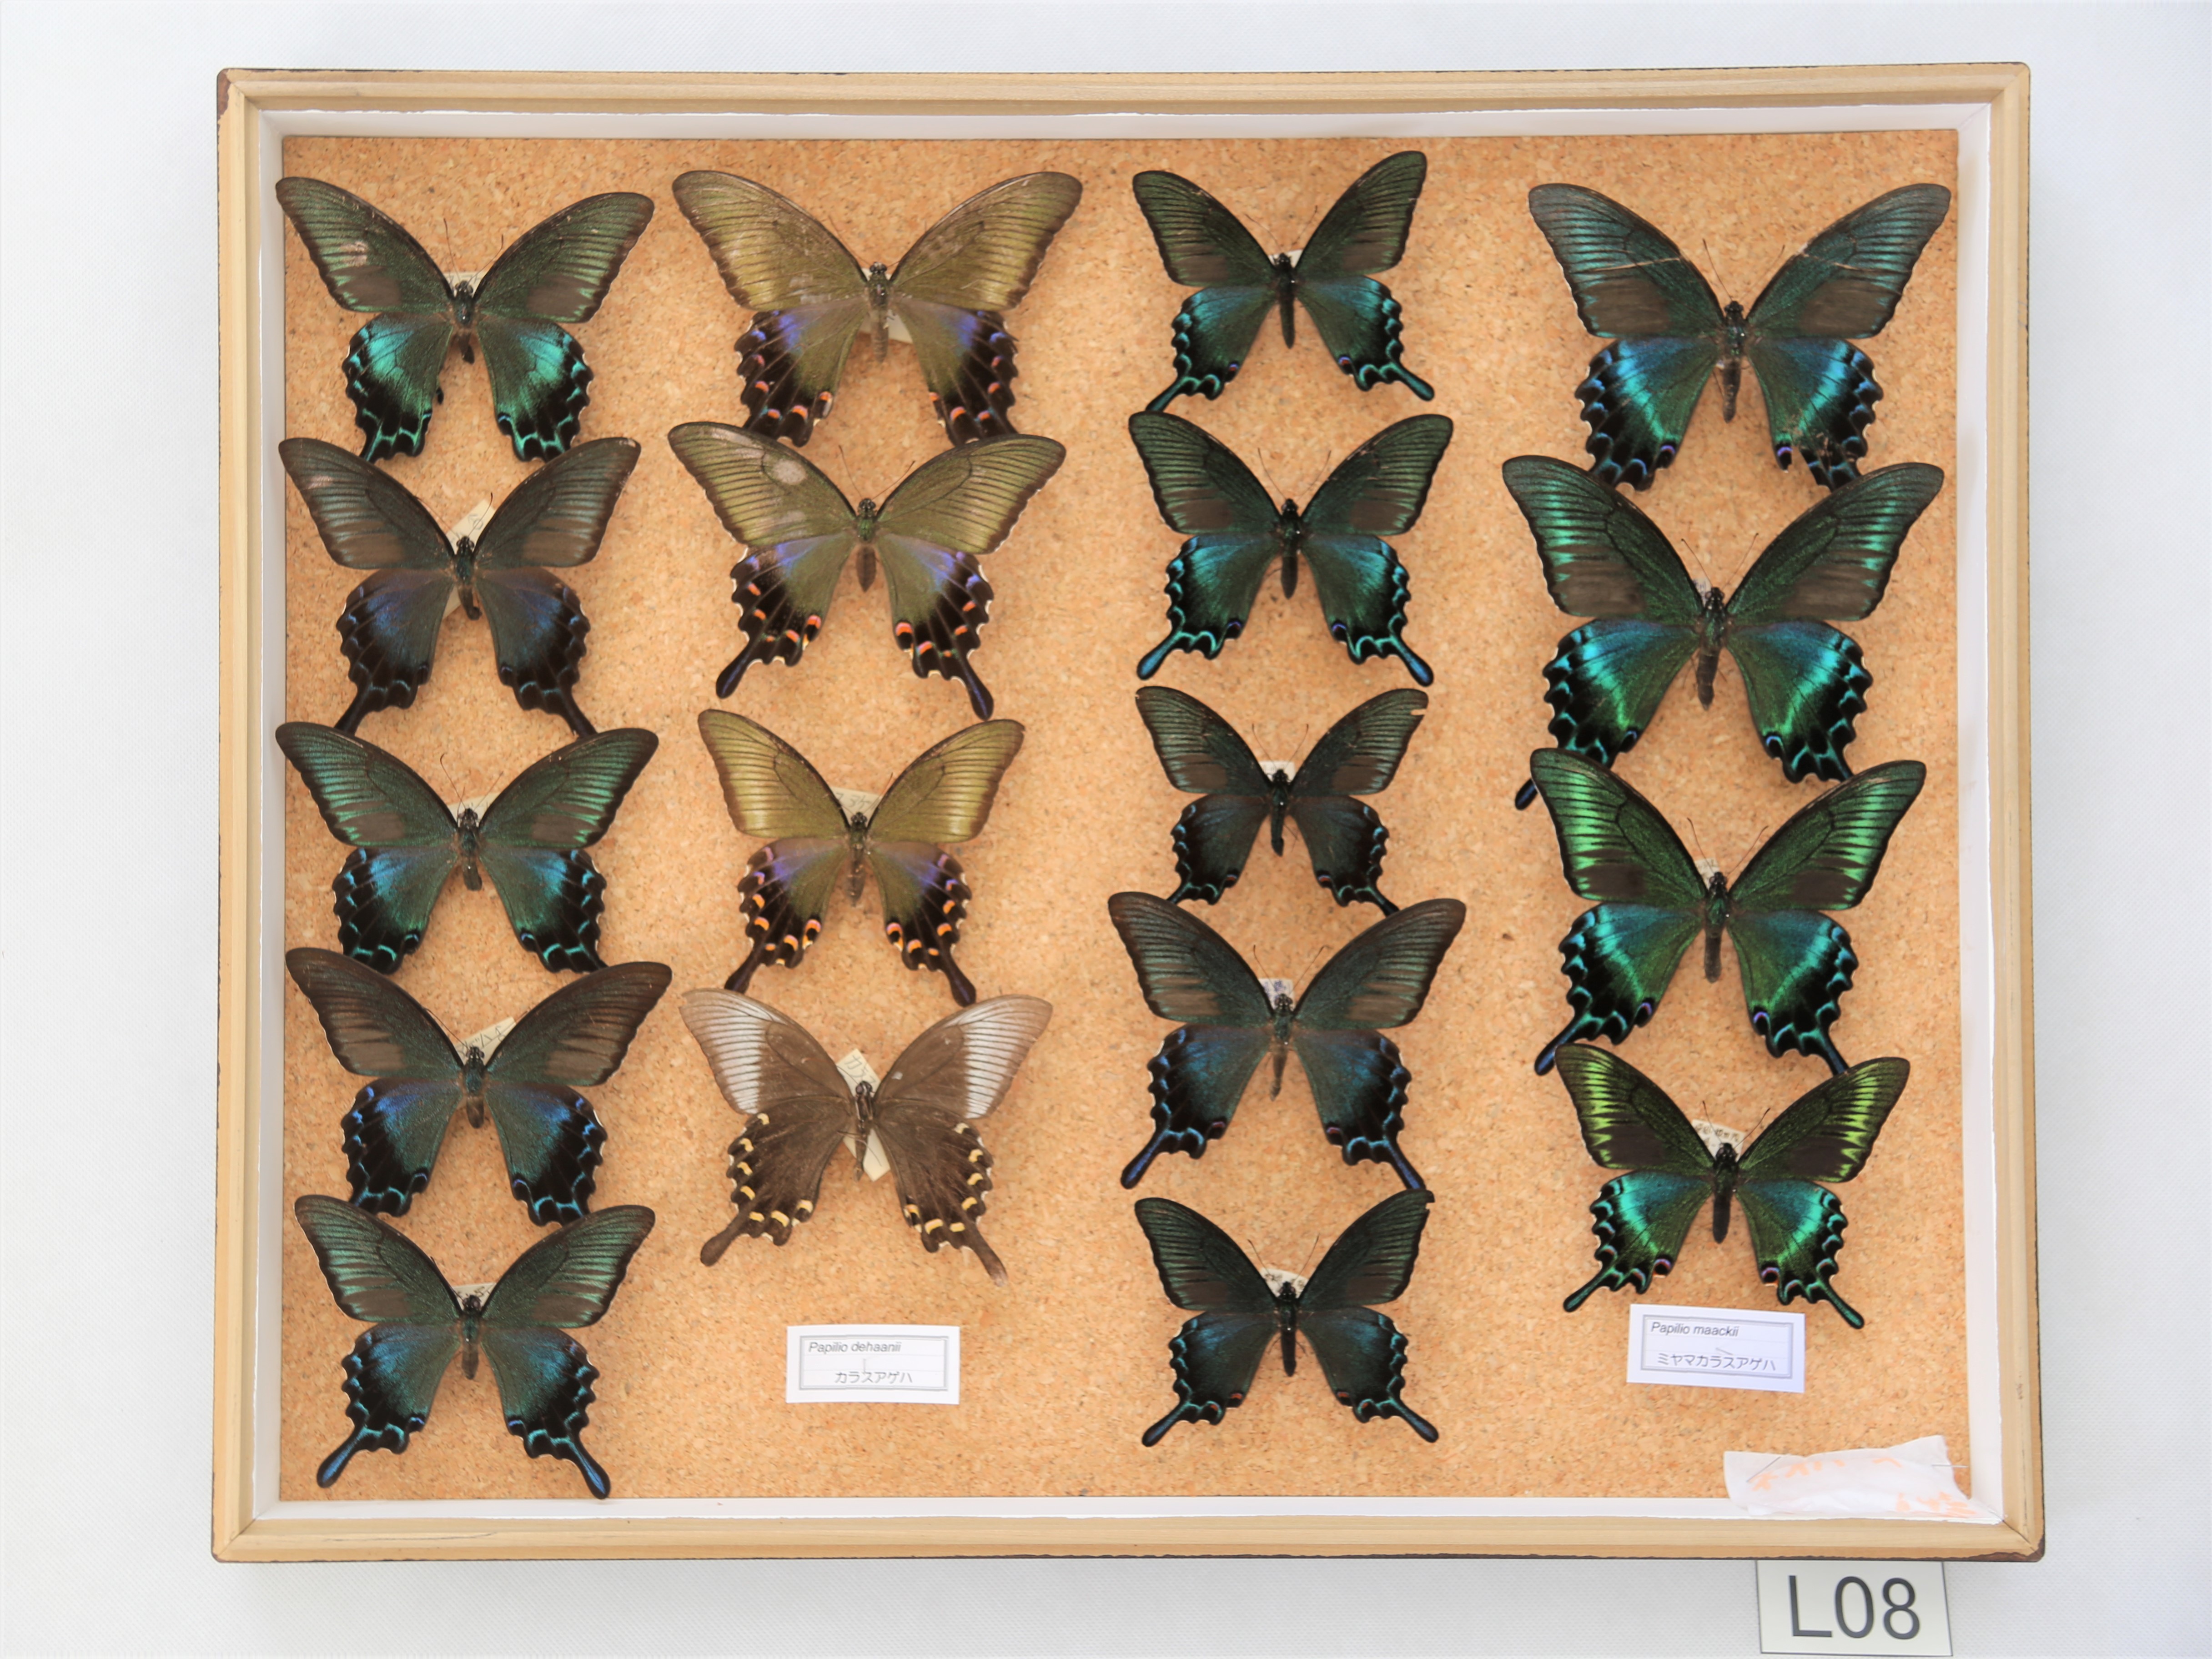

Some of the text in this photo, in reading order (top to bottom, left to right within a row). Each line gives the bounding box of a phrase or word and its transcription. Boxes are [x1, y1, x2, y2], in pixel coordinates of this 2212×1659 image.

[1650, 1322, 1739, 1337] Papilio maackii
[808, 1341, 902, 1355] Papilio dehaanii
[1657, 1352, 1776, 1372] ミヤマカラスアゲハ
[834, 1371, 913, 1384] カラスアゲハ
[1788, 1574, 1920, 1640] L08
